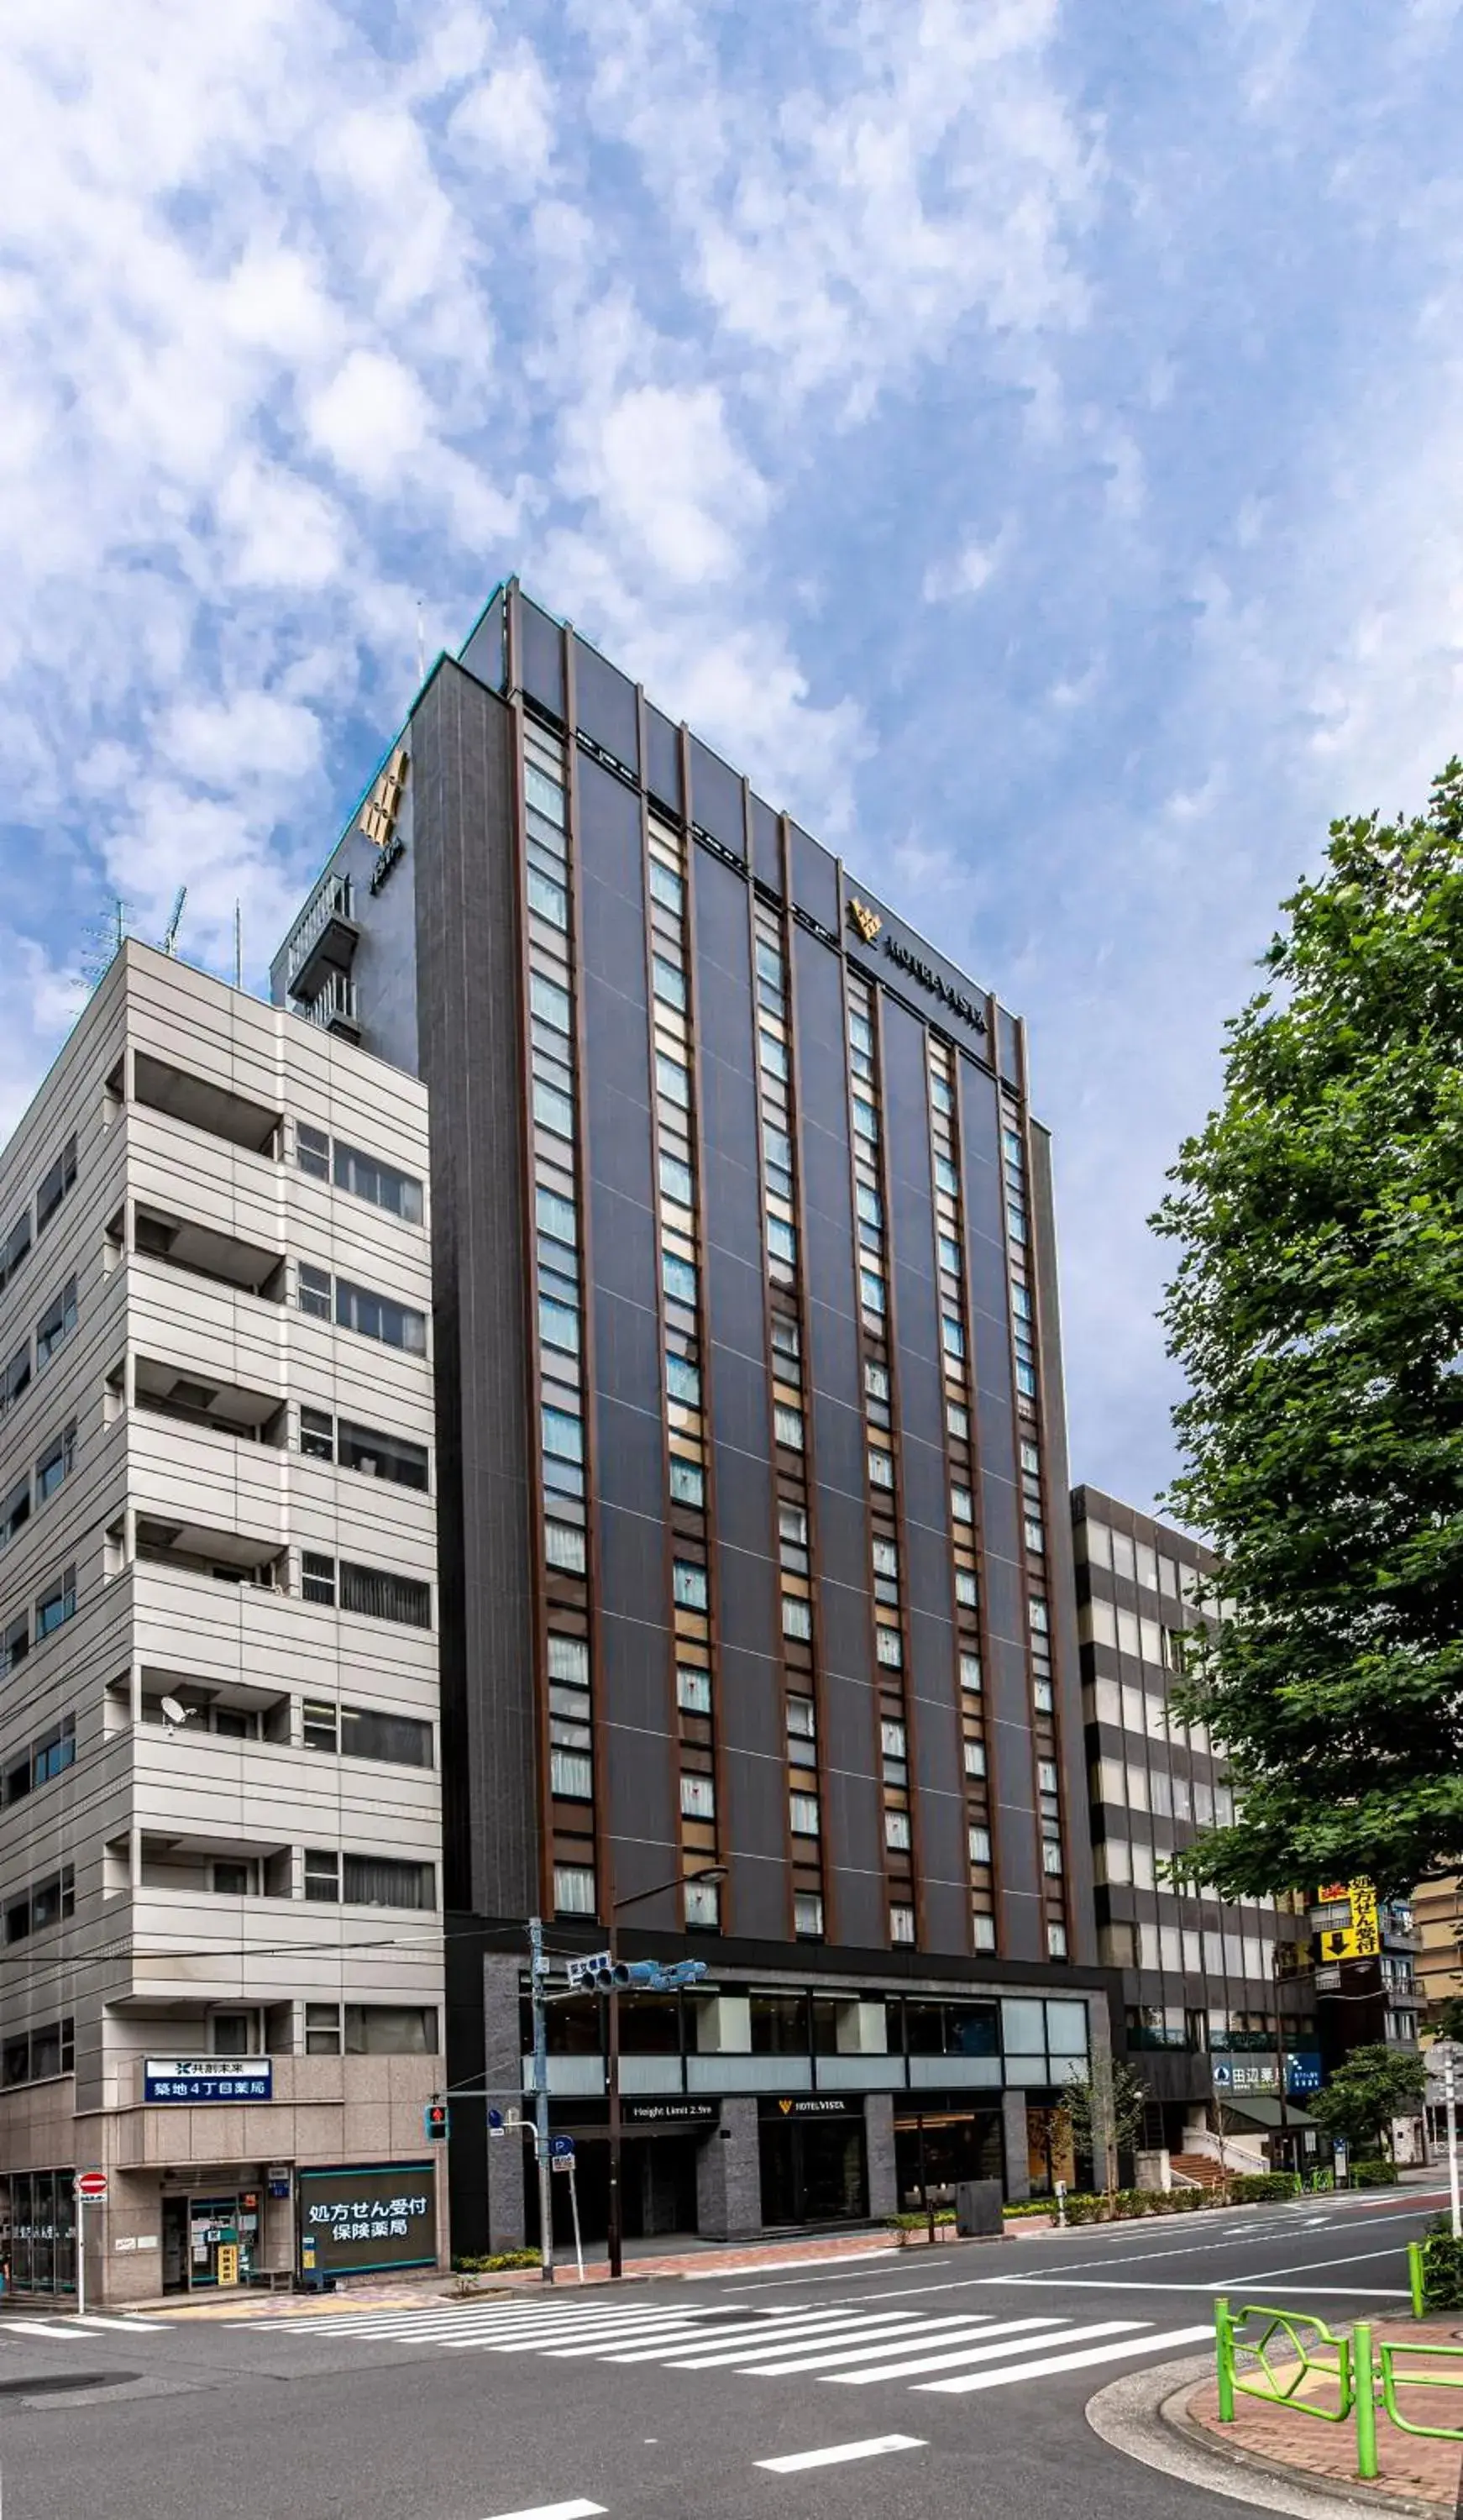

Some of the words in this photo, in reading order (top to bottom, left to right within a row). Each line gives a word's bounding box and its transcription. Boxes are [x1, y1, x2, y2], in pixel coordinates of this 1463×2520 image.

[155, 2082, 265, 2096] 築地4丁目薬局
[309, 2197, 427, 2223] 処方せん受付
[333, 2218, 407, 2241] 保険薬局
